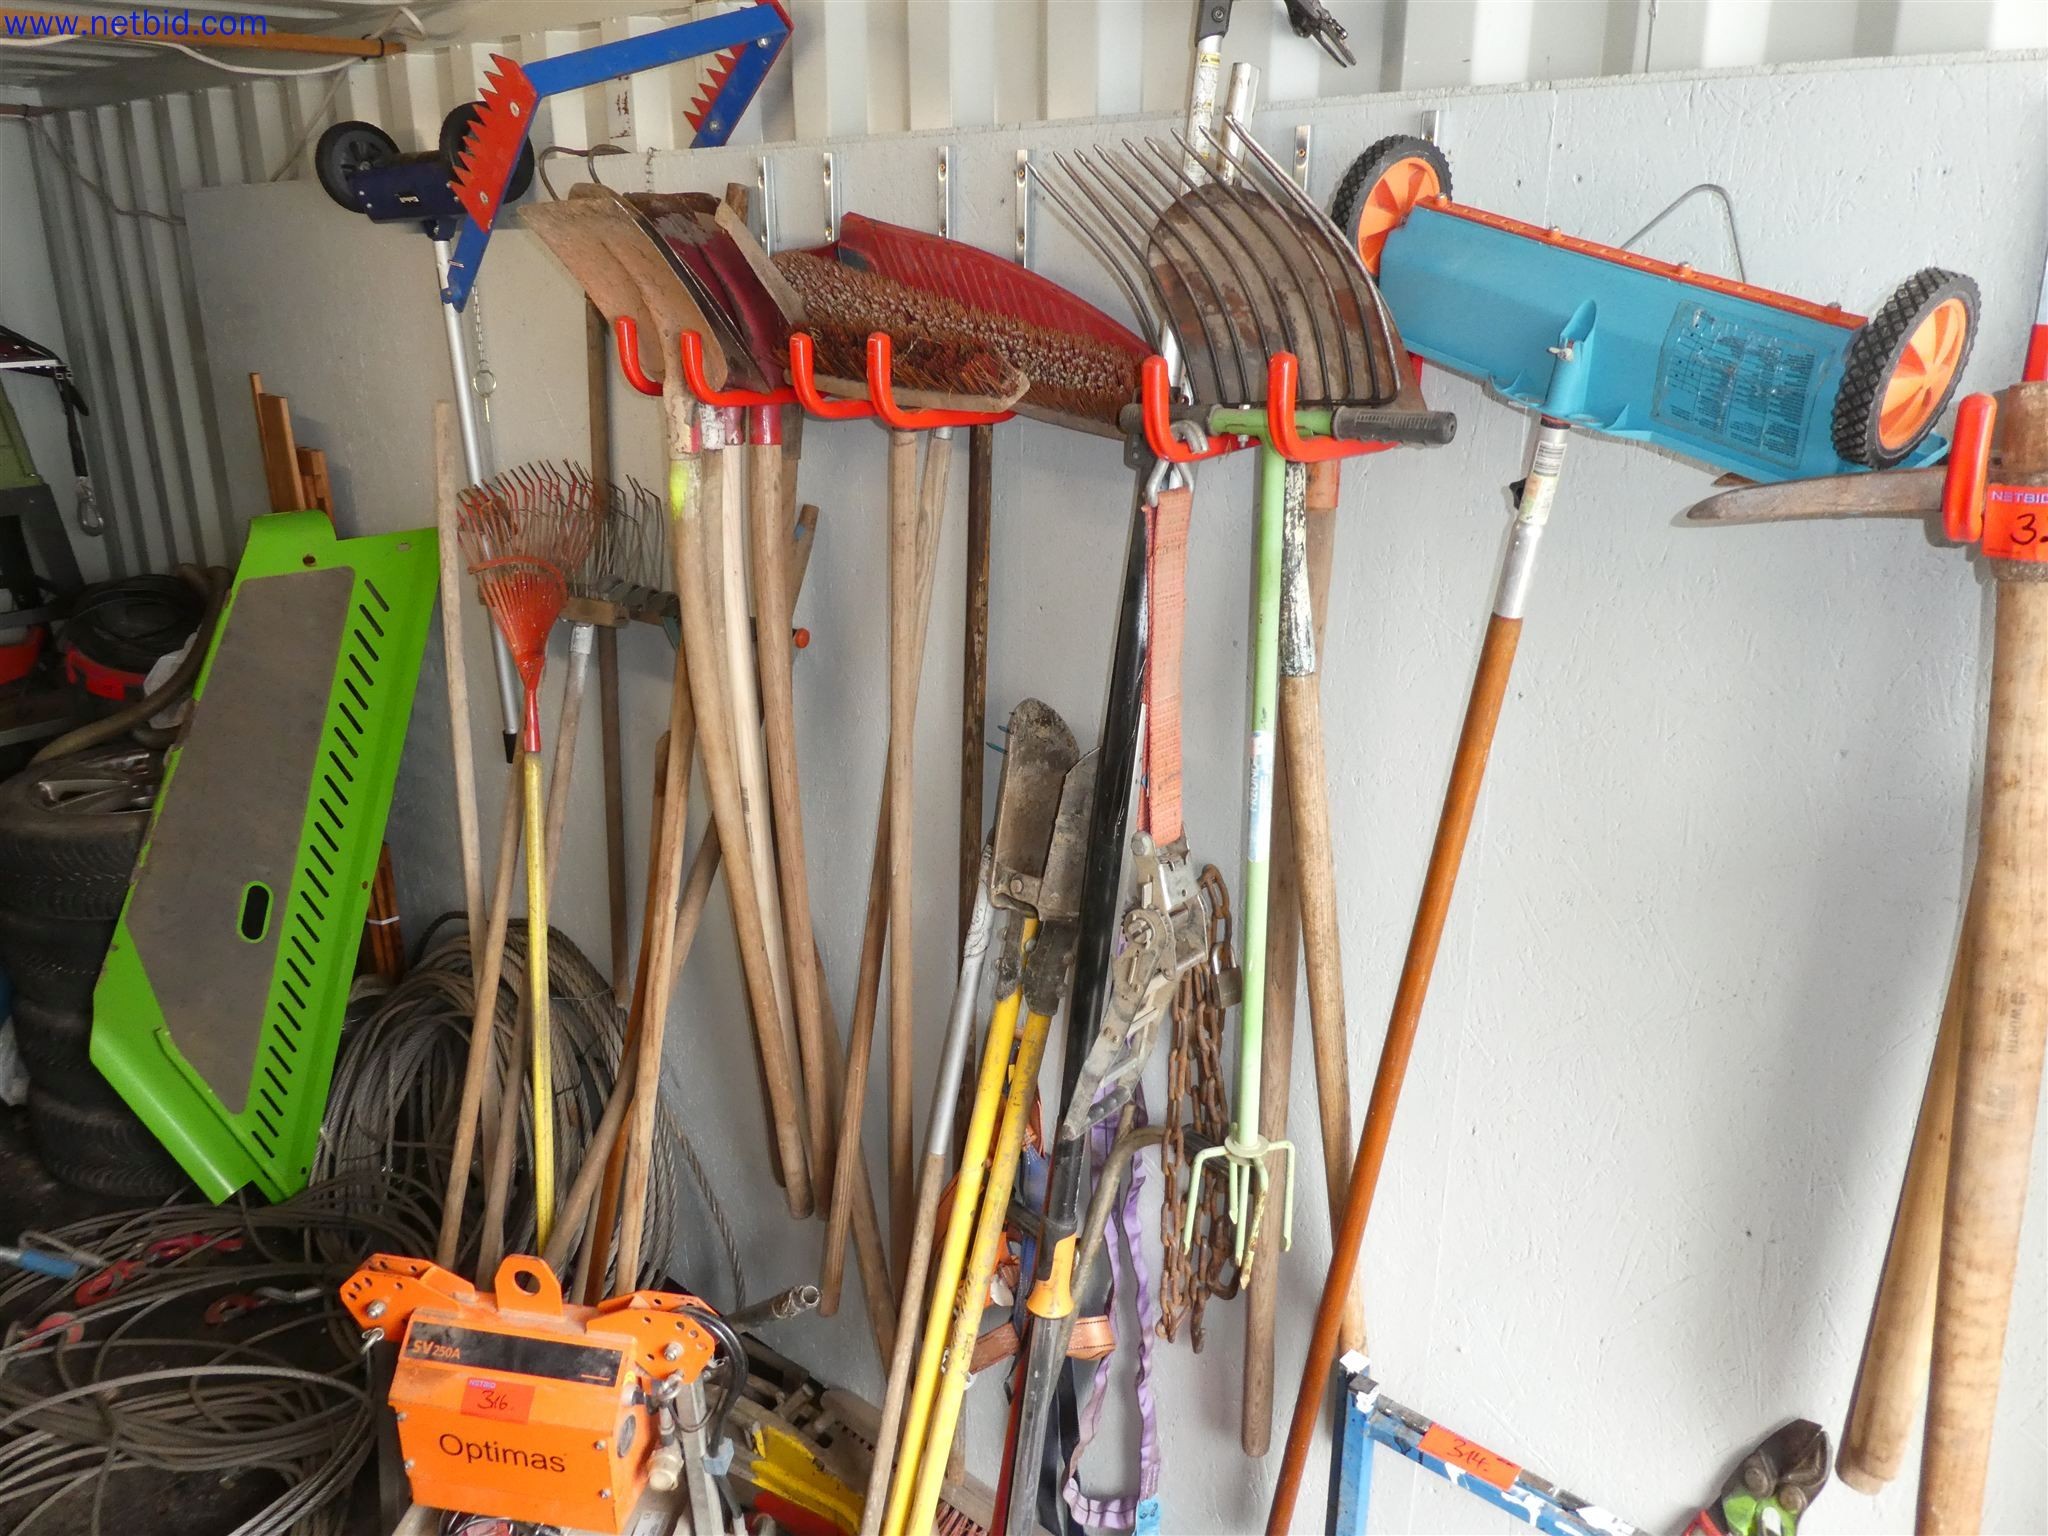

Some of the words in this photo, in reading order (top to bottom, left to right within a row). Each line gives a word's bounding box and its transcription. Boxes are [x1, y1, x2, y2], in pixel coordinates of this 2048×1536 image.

[413, 1340, 434, 1354] SV
[432, 1344, 460, 1360] 250A
[440, 1433, 565, 1473] Optimas
